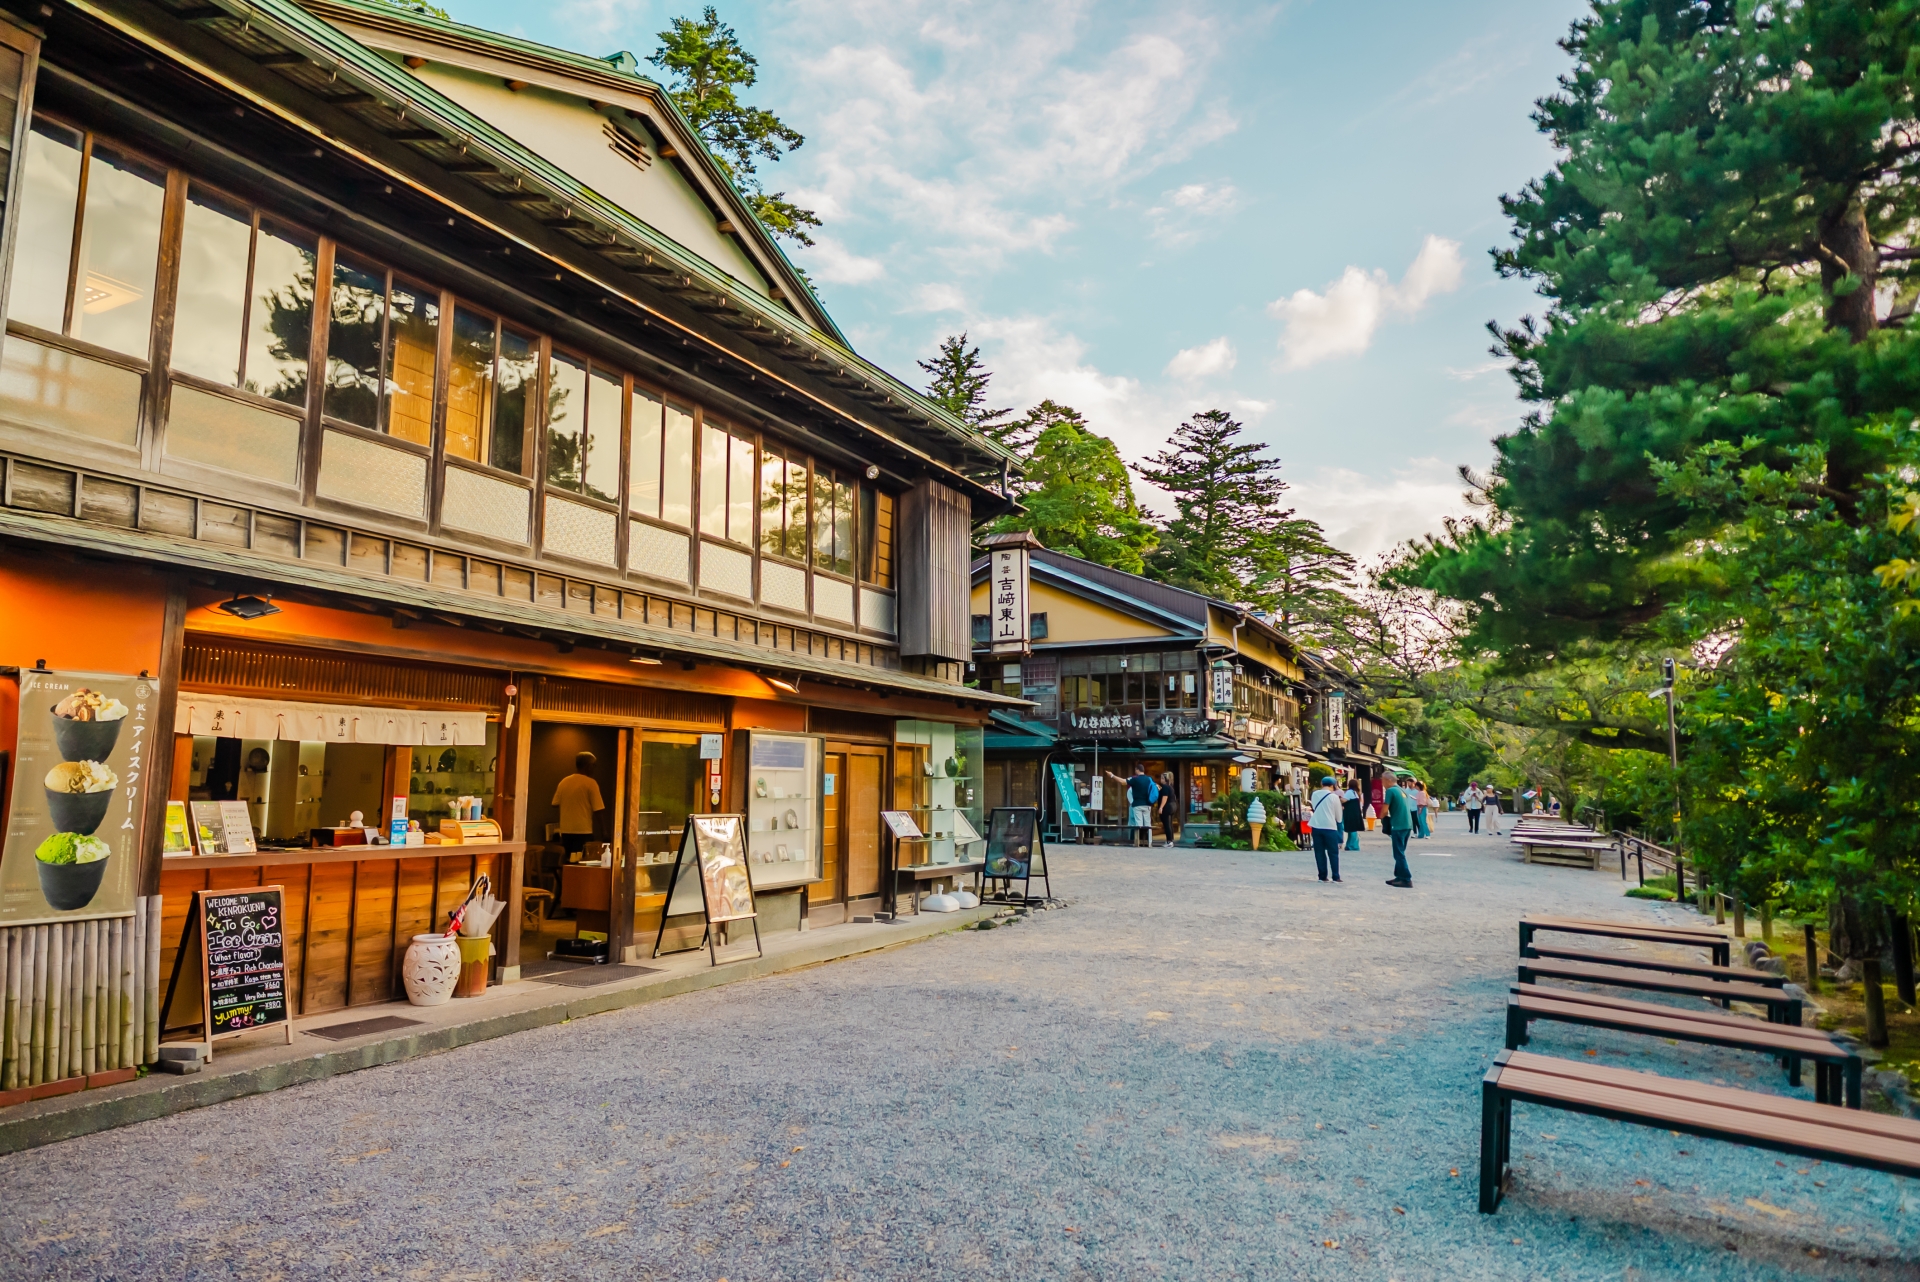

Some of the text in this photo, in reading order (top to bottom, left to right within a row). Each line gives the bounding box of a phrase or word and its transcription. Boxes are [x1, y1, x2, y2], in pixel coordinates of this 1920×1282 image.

[30, 681, 69, 690] ICE CREAM
[337, 716, 347, 738] 東山
[440, 722, 448, 741] 東山
[206, 896, 249, 909] WELCOME TO
[222, 916, 256, 931] To Go
[207, 927, 282, 951] Ice Cream
[214, 953, 231, 962] What
[244, 963, 257, 973] Rich
[244, 975, 259, 984] Kaga
[244, 993, 256, 1002] Very
